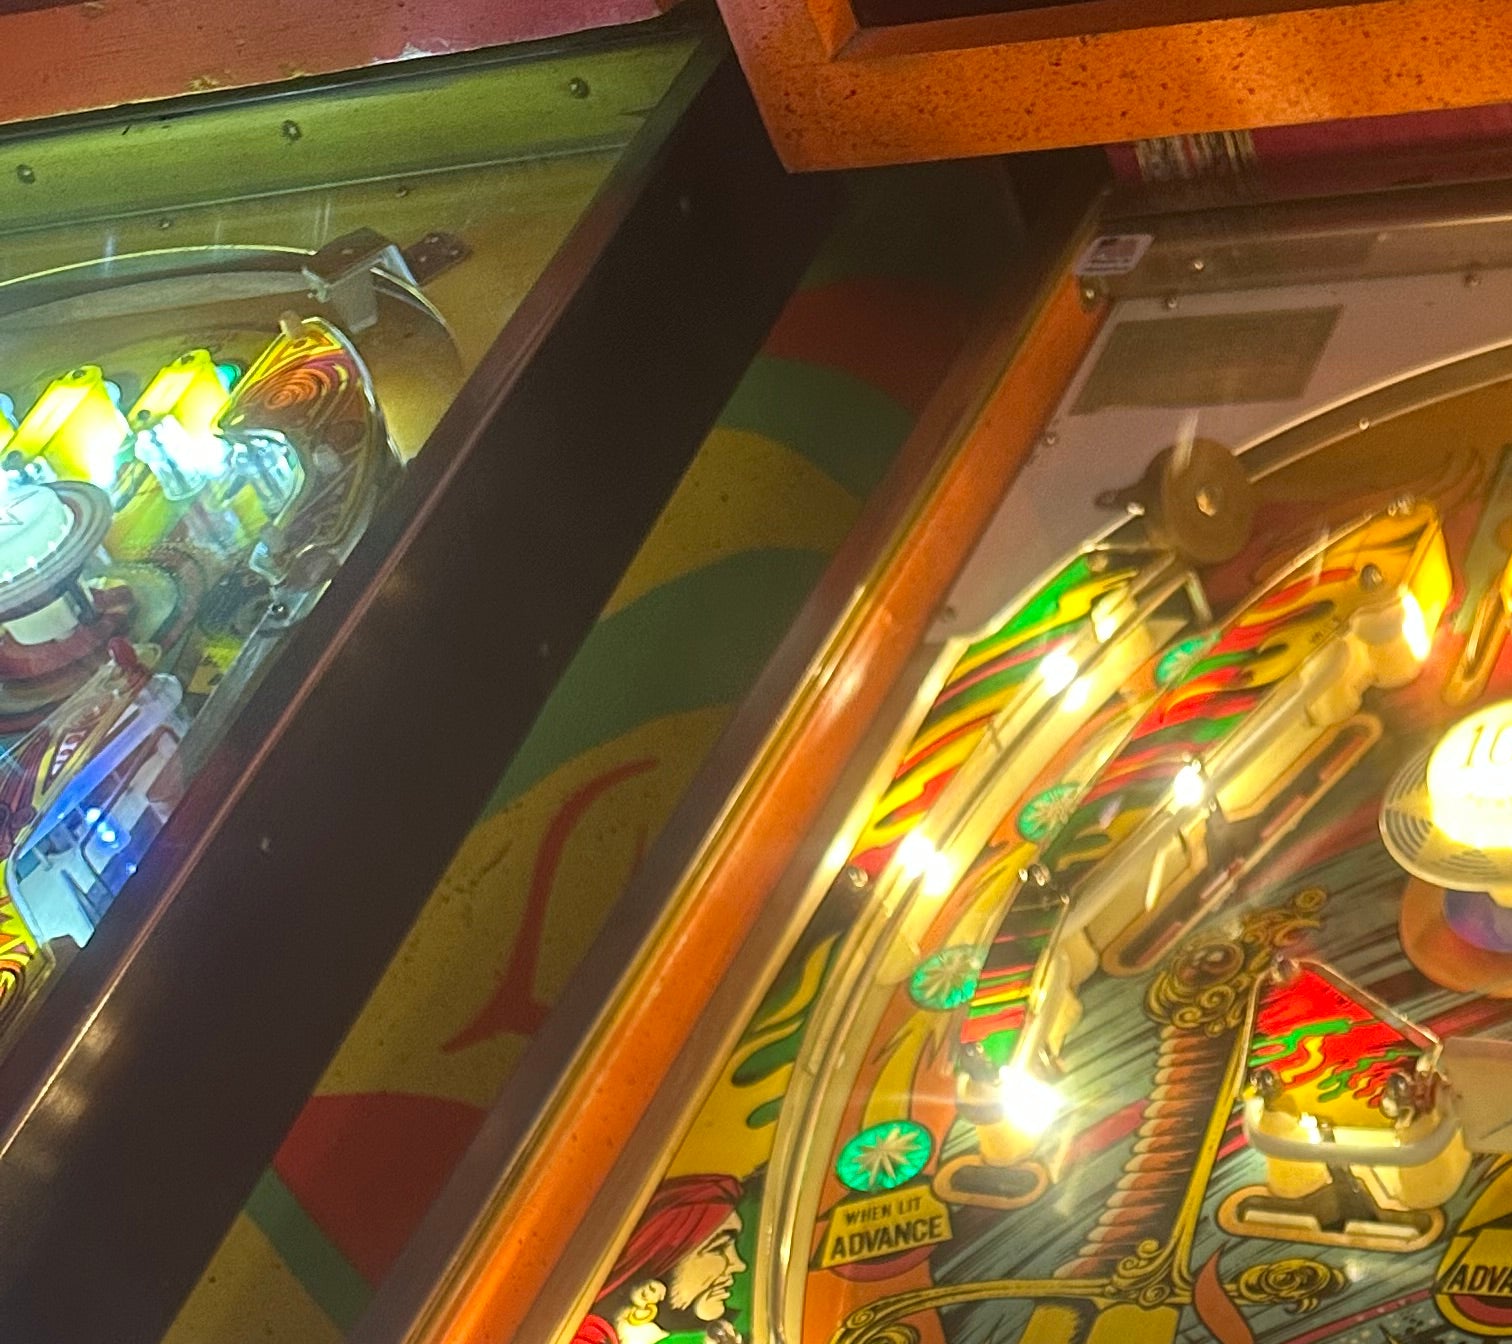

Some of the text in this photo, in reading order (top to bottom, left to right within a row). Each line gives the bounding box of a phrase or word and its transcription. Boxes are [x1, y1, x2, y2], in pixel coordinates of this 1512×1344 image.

[845, 1196, 921, 1226] WHEN LIT
[830, 1214, 943, 1261] ADVANCE
